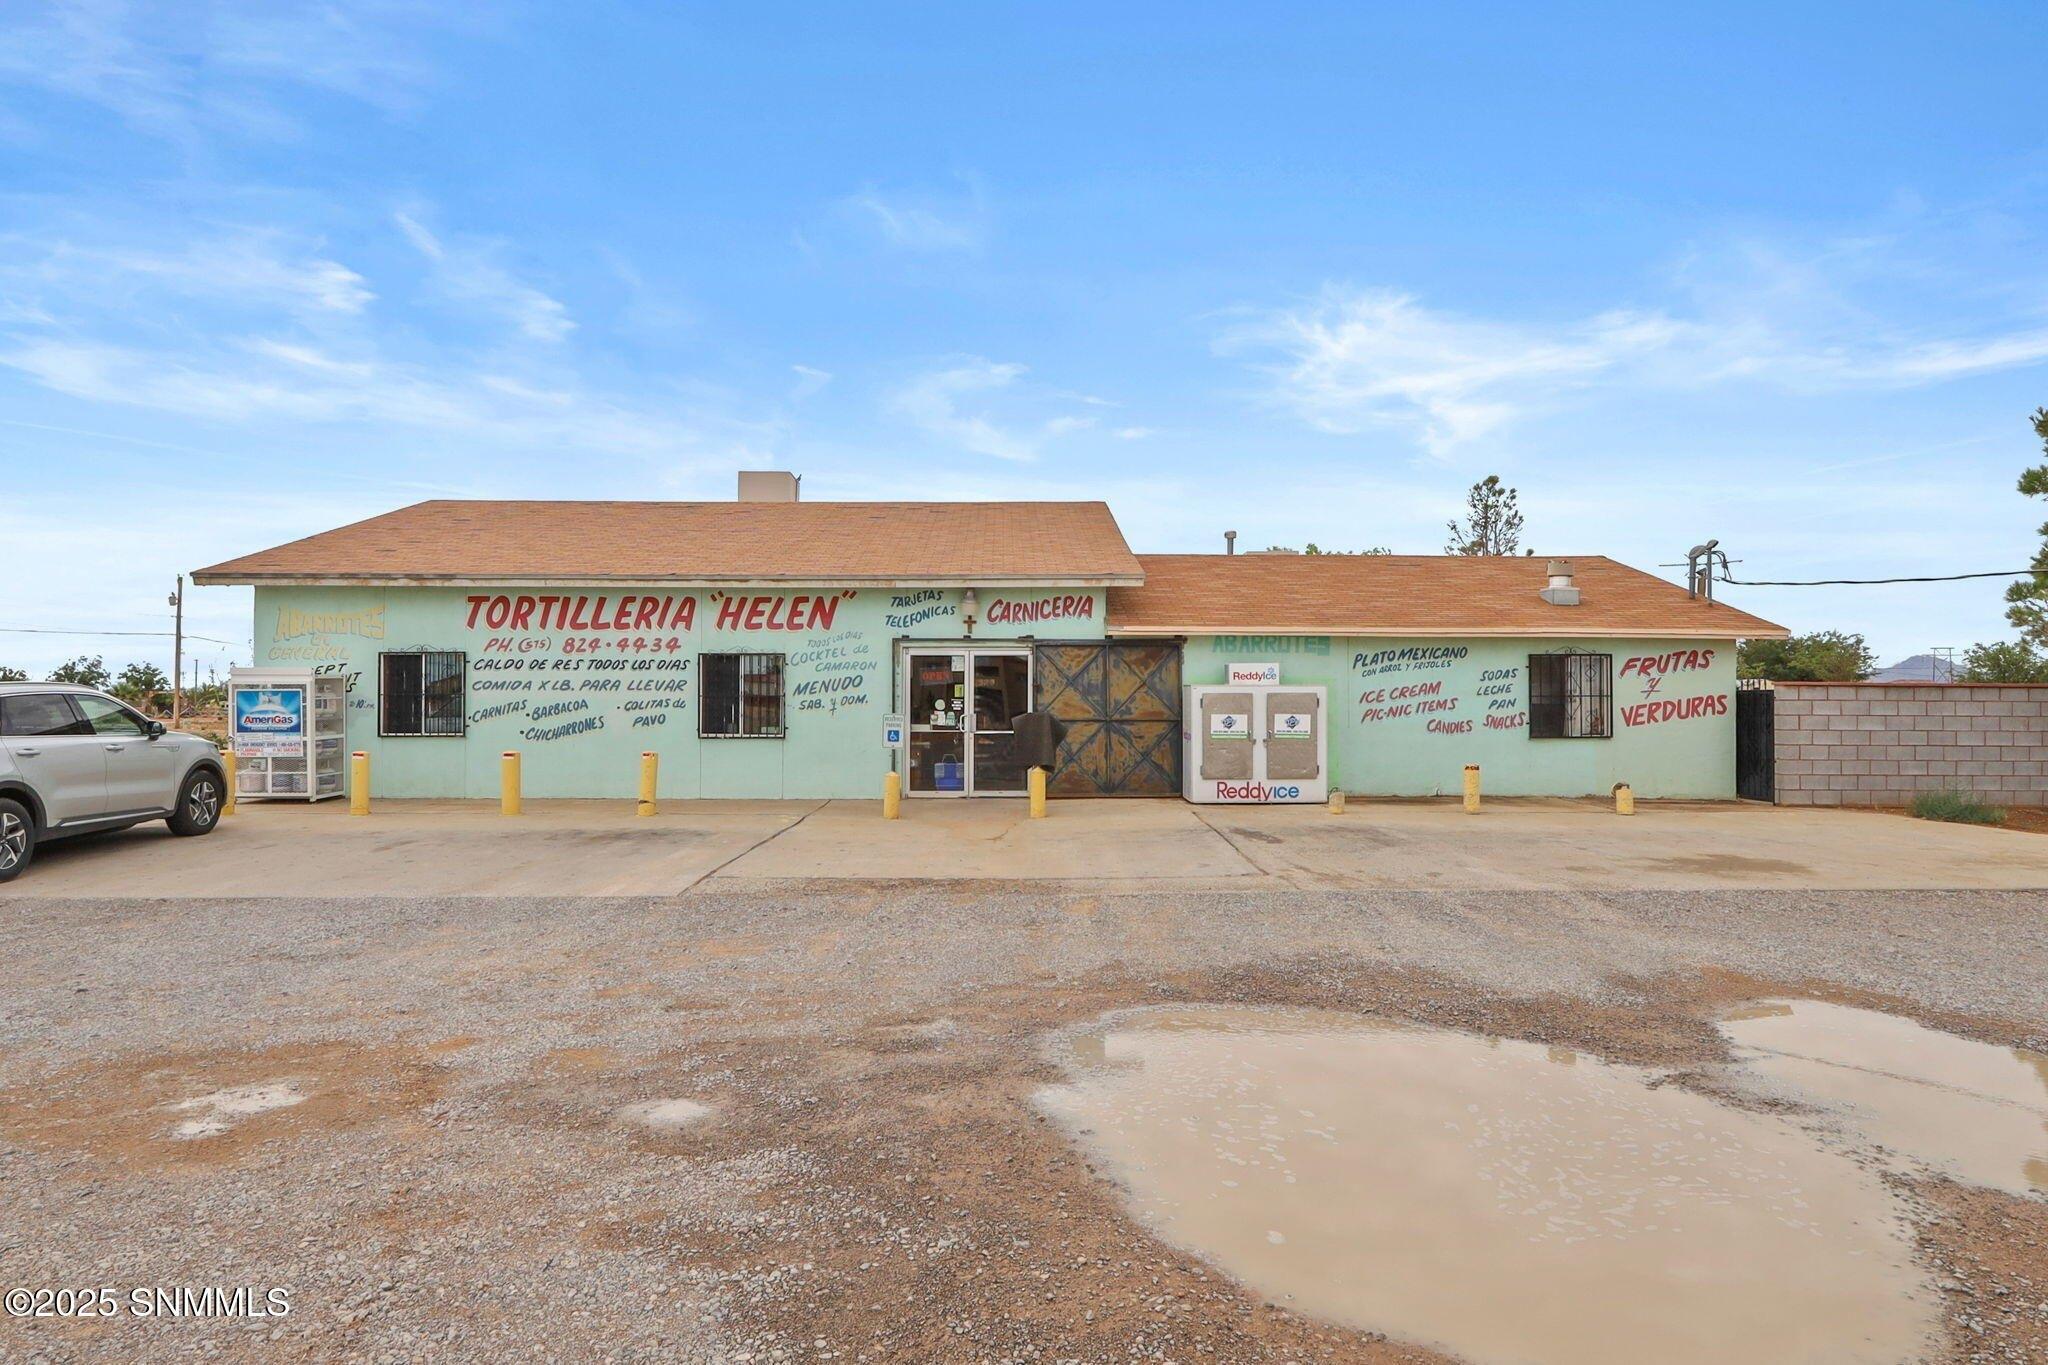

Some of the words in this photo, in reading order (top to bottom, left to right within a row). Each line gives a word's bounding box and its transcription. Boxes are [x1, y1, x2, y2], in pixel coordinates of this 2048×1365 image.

[891, 589, 943, 608] TARJETAS
[466, 595, 697, 632] TORTILLERIA
[710, 590, 857, 632] "HELEN"
[885, 605, 956, 628] TELEFONICAS
[987, 595, 1095, 623] CARNICERIA
[483, 637, 513, 653] PH.
[518, 637, 552, 653] (575)
[473, 658, 524, 671] CALDO
[529, 658, 548, 671] DE
[552, 658, 584, 671] RES
[587, 658, 628, 671] TODOS
[631, 658, 653, 671] LOS
[656, 658, 690, 671] DIAS
[790, 647, 847, 667] COCKTEL
[853, 643, 869, 655] de
[1352, 652, 1397, 669] PLATO
[1397, 646, 1469, 662] MEXICANO
[1619, 649, 1715, 678] FRUTAS
[815, 660, 878, 673] CAMARON
[1362, 666, 1377, 678] CON
[1379, 662, 1402, 674] ARROZ
[1404, 663, 1411, 672] Y
[1413, 659, 1452, 671] FRIJOLES
[1480, 668, 1519, 682] SODAS
[472, 680, 532, 692] COMIDA
[538, 680, 550, 691] X
[551, 681, 575, 692] LB.
[579, 680, 621, 692] PARA
[627, 679, 688, 692] LLEVAR
[793, 675, 864, 697] MENUDO
[1360, 688, 1386, 704] ICE
[1389, 681, 1442, 700] CREAM
[1476, 683, 1514, 696] LECHE
[471, 699, 528, 723] CARNITAS
[531, 699, 589, 721] BARBACOA
[624, 699, 670, 711] COLITAS
[672, 698, 687, 709] de
[799, 698, 825, 710] SAB.
[840, 694, 868, 706] DOM.
[1361, 704, 1412, 723] PIC-NIC
[1415, 698, 1458, 713] ITEMS
[1488, 698, 1517, 710] PAN
[1620, 694, 1728, 727] VERDURAS
[243, 715, 294, 724] AmeriGas
[525, 716, 605, 741] CHICHARRONES
[632, 713, 666, 727] PAVO
[1427, 719, 1473, 734] CANDIES
[1483, 712, 1526, 730] SNACKS
